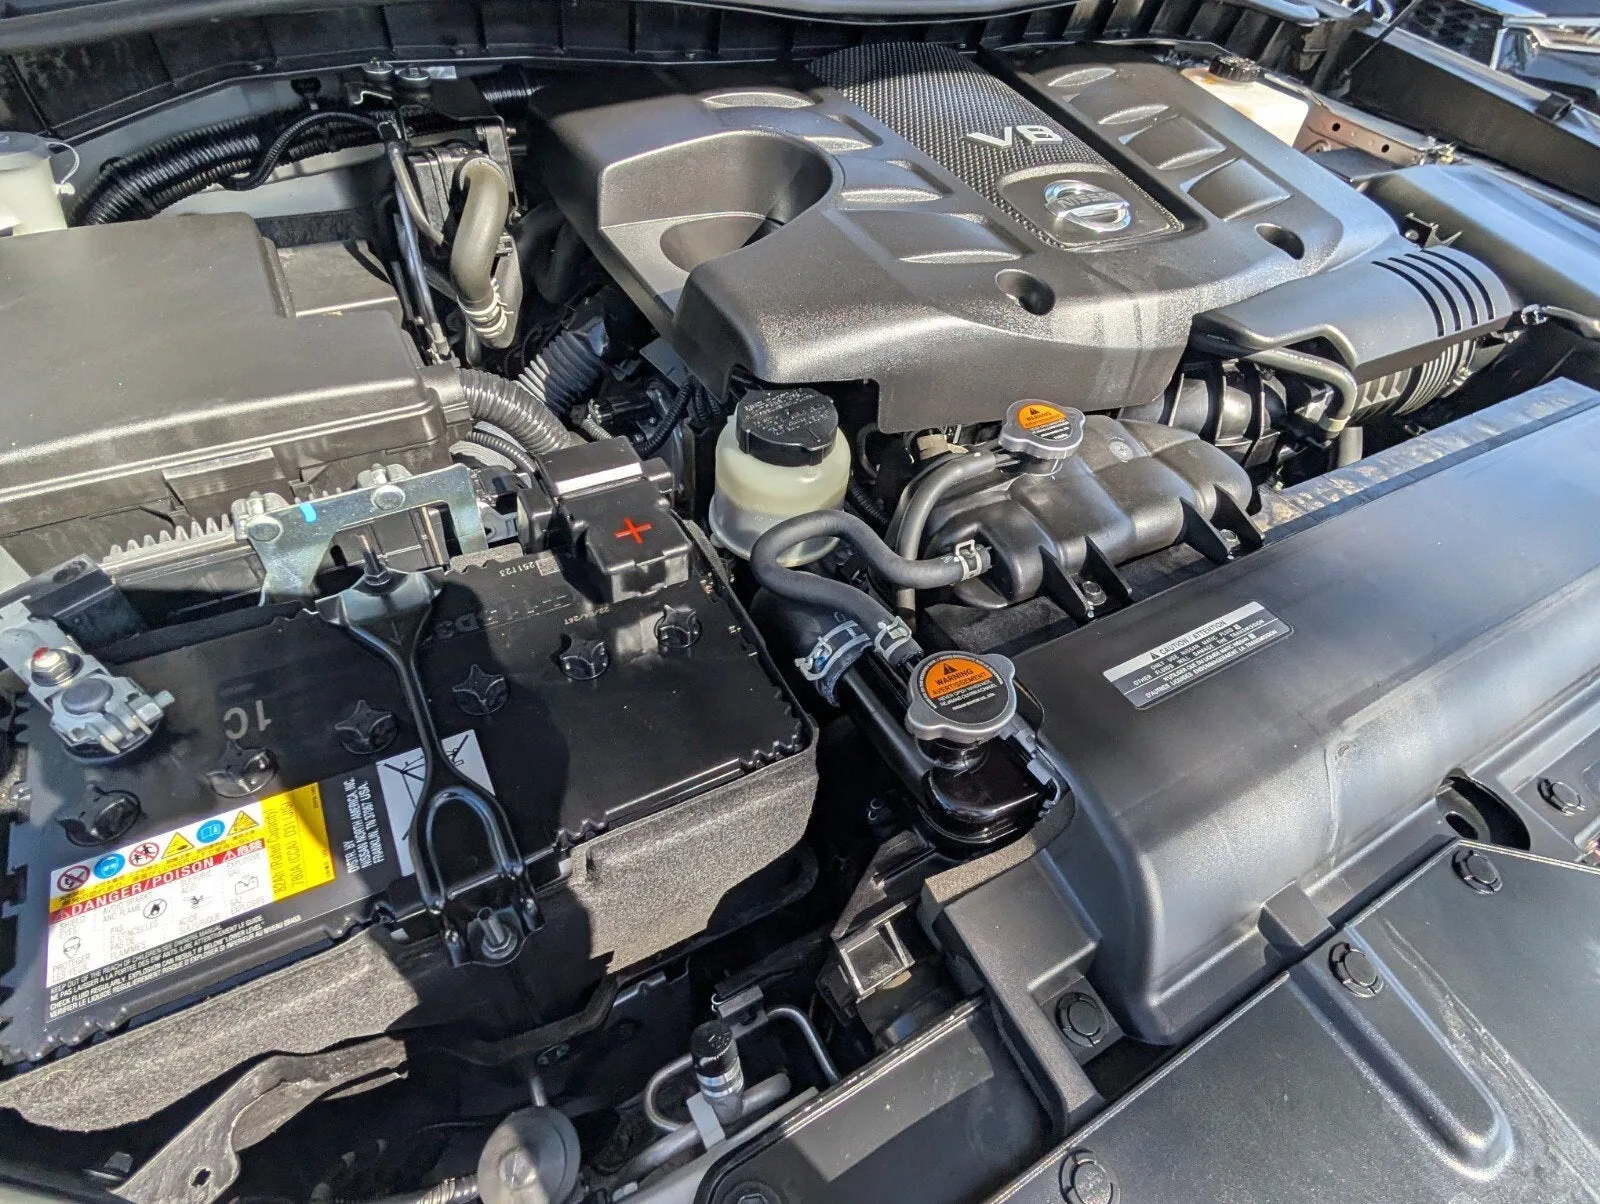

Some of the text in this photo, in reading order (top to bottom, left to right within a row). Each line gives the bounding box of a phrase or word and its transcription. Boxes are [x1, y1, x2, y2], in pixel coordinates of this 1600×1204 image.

[967, 125, 1063, 149] V8
[1057, 190, 1121, 208] NISSAN
[1158, 637, 1189, 654] CAUTION
[1191, 620, 1227, 639] ATTENTION
[1132, 674, 1152, 685] OTHER
[1154, 663, 1174, 675] FLUIDS
[1176, 655, 1190, 664] WILL
[1192, 643, 1214, 656] DAMAGE
[1229, 619, 1264, 637] TRANSMISSION
[932, 671, 986, 695] AVERTISSEMENT
[934, 668, 973, 685] WARNING
[223, 699, 272, 740] 1C
[351, 819, 366, 843] NORTH
[365, 818, 376, 829] TN
[263, 806, 287, 894] 82Ah (Rated Capacity)
[279, 800, 304, 888] 780A (CCA) D31 (JIS)
[343, 840, 355, 850] BY
[357, 841, 372, 868] NISSAN
[71, 856, 213, 916] DANGER/POISON
[59, 915, 85, 931] SHIELD
[102, 902, 140, 922] AND FLAME
[59, 925, 76, 939] EYES
[50, 993, 58, 1001] NE
[60, 987, 72, 997] PAS
[74, 977, 98, 992] LAISSER
[105, 972, 113, 980] LA
[137, 958, 149, 968] DES
[193, 924, 237, 945] ATTENTIVEMENT
[237, 921, 245, 929] LE
[50, 1002, 77, 1017] VERIFIER
[78, 998, 86, 1007] LE
[88, 988, 111, 1003] LIQUIDE
[254, 929, 263, 937] AU
[263, 921, 283, 933] NIVEAU
[50, 983, 66, 994] KEEP
[67, 977, 79, 988] OUT
[80, 974, 88, 982] OF
[90, 969, 101, 978] THE
[102, 962, 122, 973] REACH
[123, 958, 130, 966] OF
[50, 997, 70, 1010] CHECK
[71, 989, 89, 1002] FLUID
[128, 962, 161, 980] EXPLOSION
[161, 957, 174, 967] CAN
